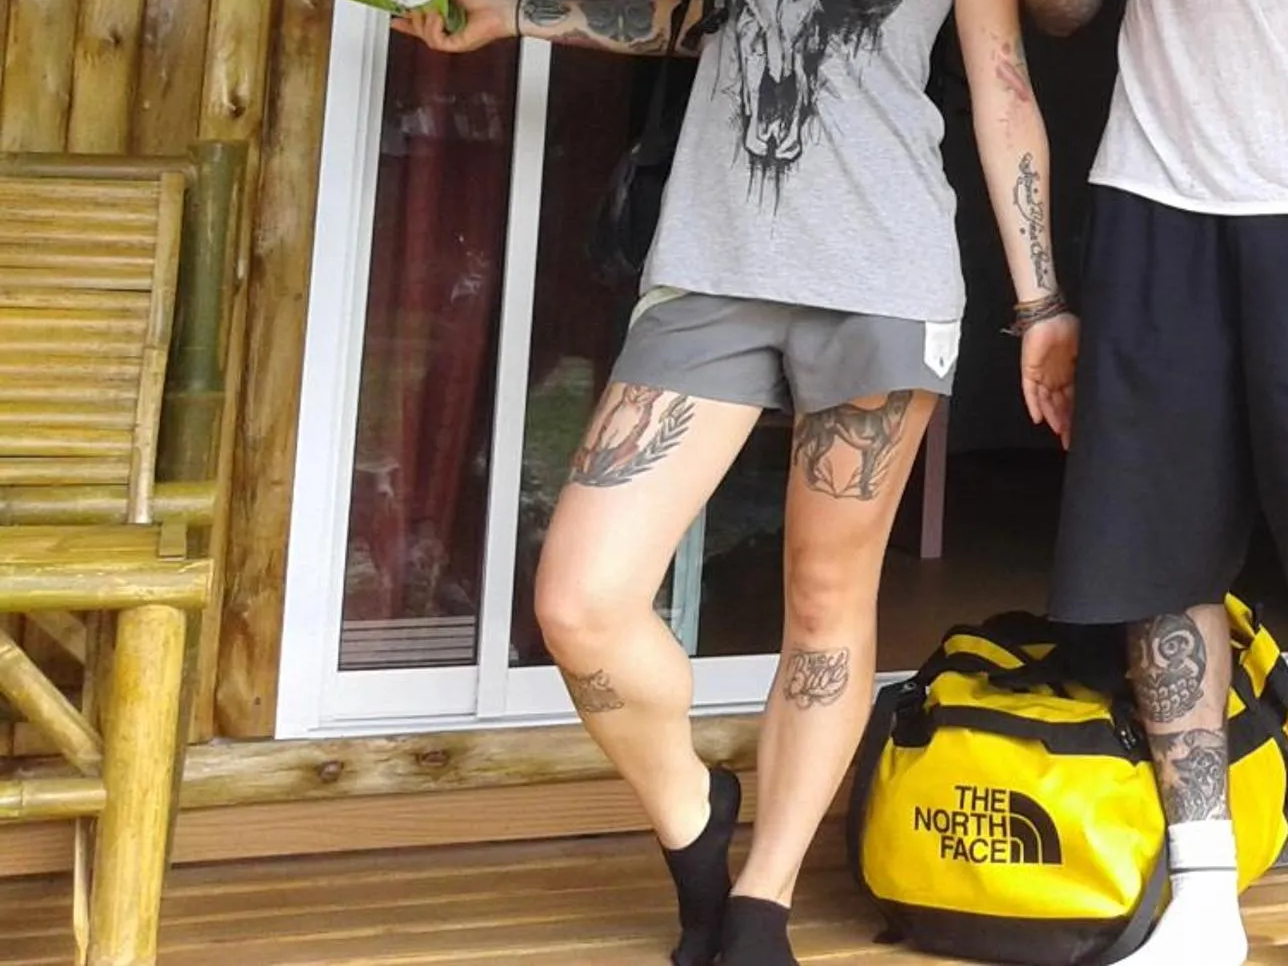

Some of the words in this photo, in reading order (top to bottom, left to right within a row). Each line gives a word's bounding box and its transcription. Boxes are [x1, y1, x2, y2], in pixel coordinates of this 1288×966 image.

[954, 785, 1007, 813] THE
[914, 806, 1008, 837] NORTH
[940, 835, 1007, 864] FACE
